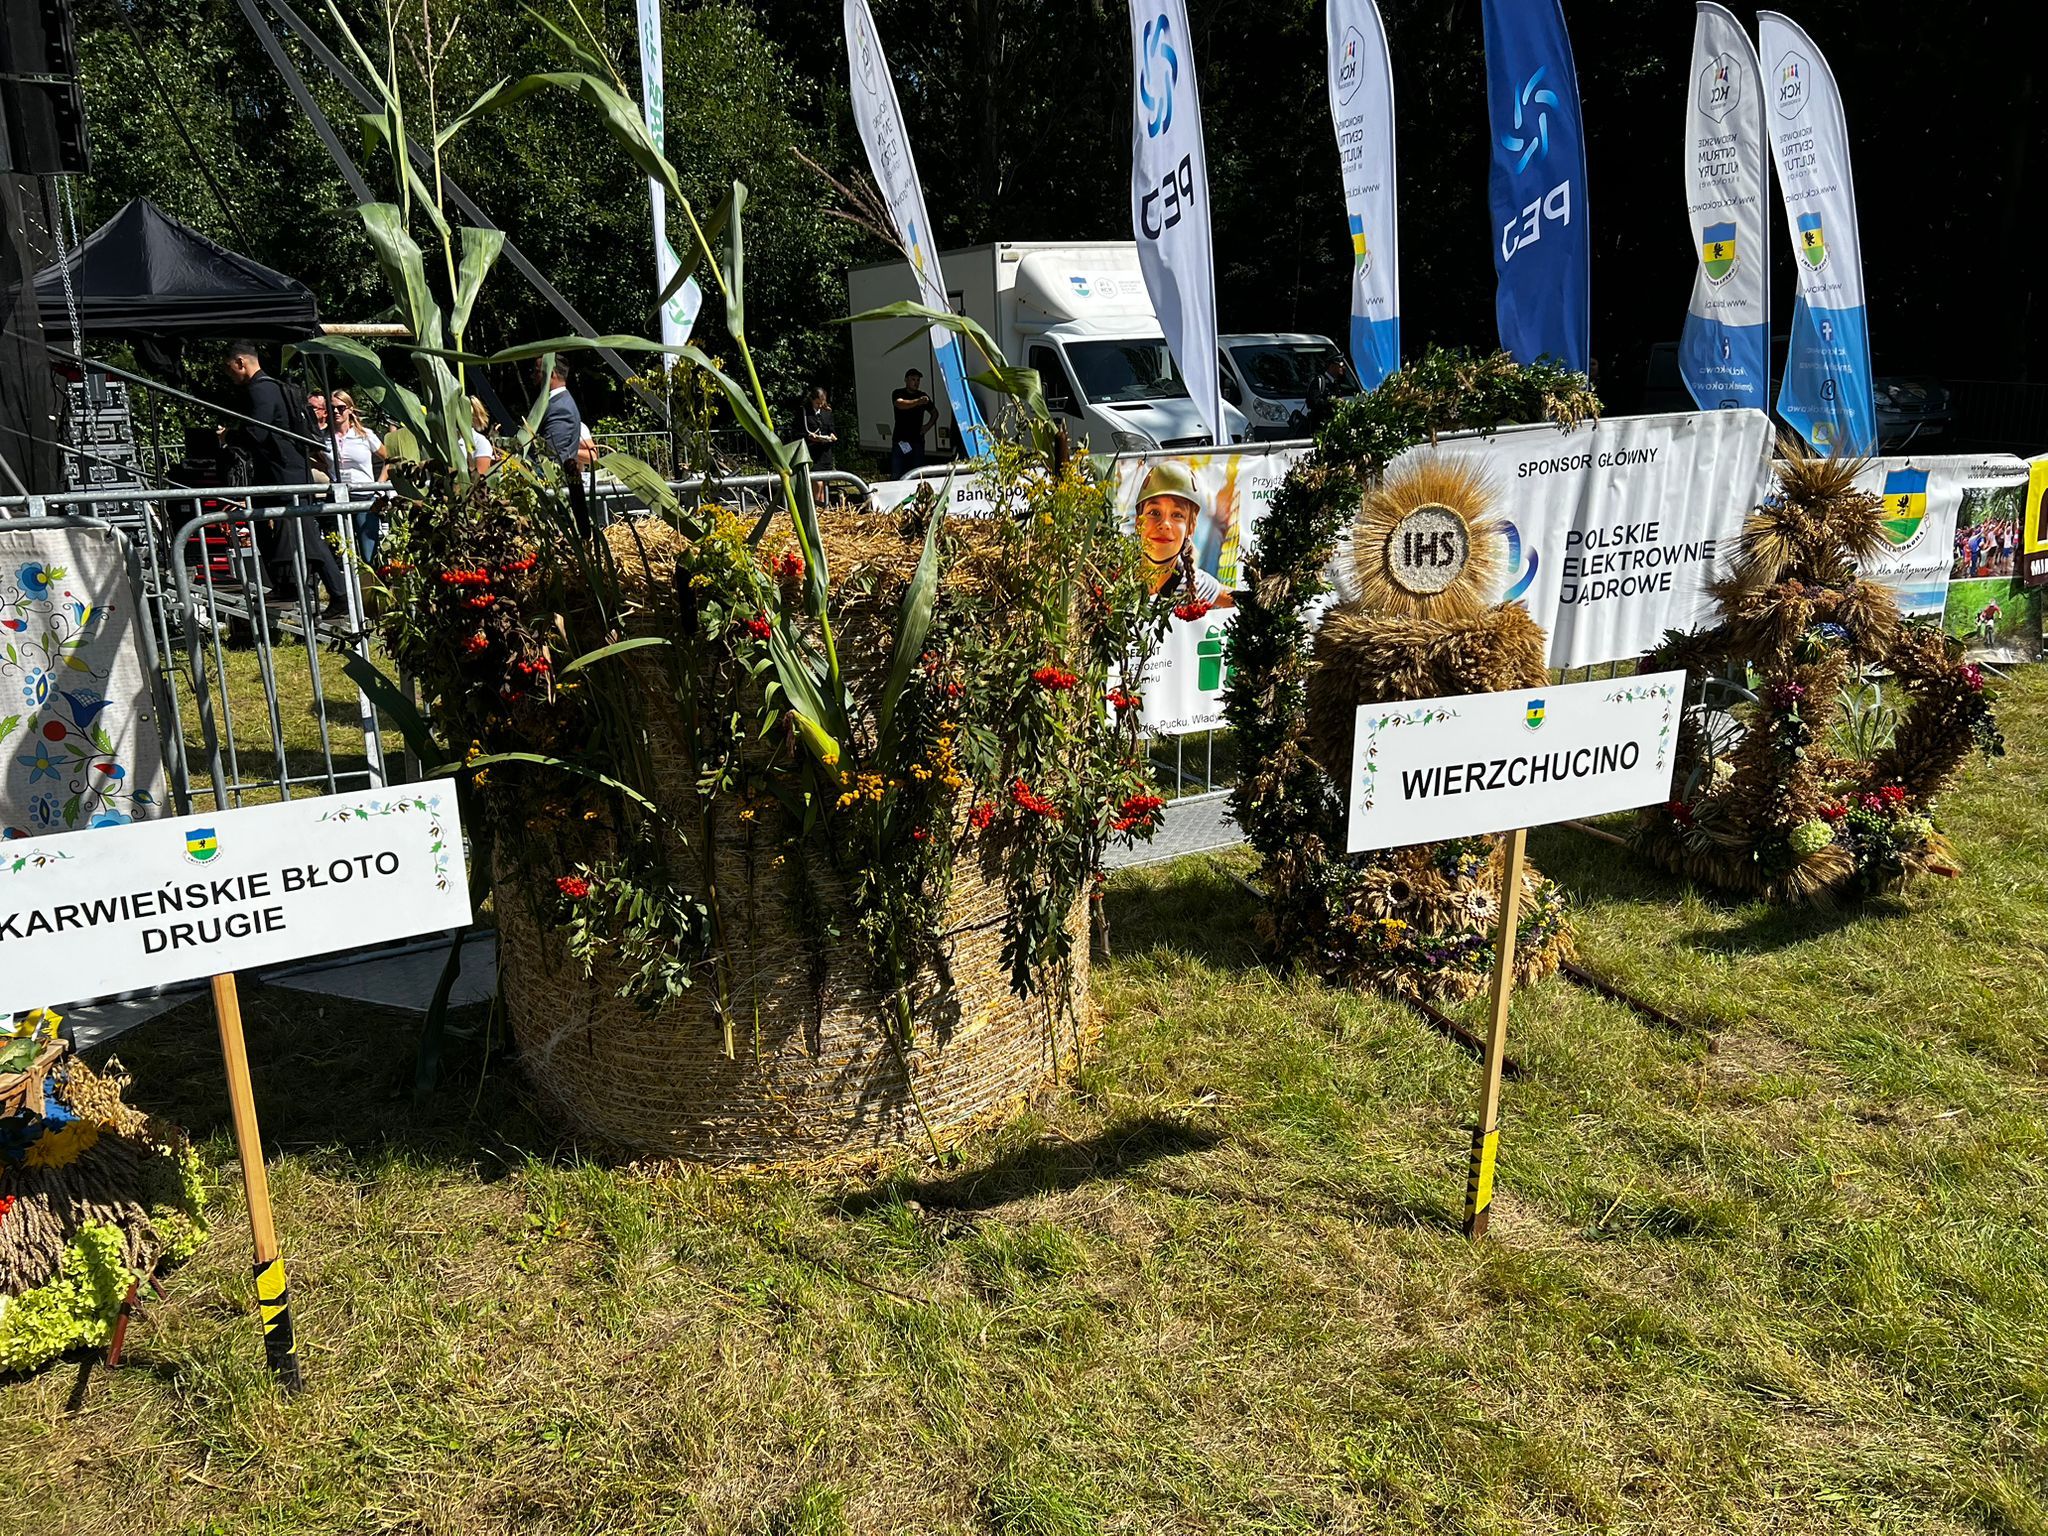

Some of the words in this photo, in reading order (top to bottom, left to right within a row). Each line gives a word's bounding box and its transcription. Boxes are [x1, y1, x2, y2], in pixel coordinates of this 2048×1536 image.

[1518, 454, 1592, 477] SPONSOR
[1598, 448, 1658, 468] GŁÓWNY
[956, 487, 993, 502] Bank
[1404, 531, 1455, 567] IHS
[1565, 522, 1659, 550] POLSKIE
[1562, 540, 1717, 577] ELEKTROWNIE
[1560, 572, 1672, 606] JĄDROWE
[1192, 713, 1220, 724] Włady
[1402, 741, 1640, 800] WIERZCHUCINO
[0, 872, 271, 942] KARWIEŃSKIE
[282, 851, 400, 892] BŁOTO
[142, 906, 286, 954] DRUGIE
